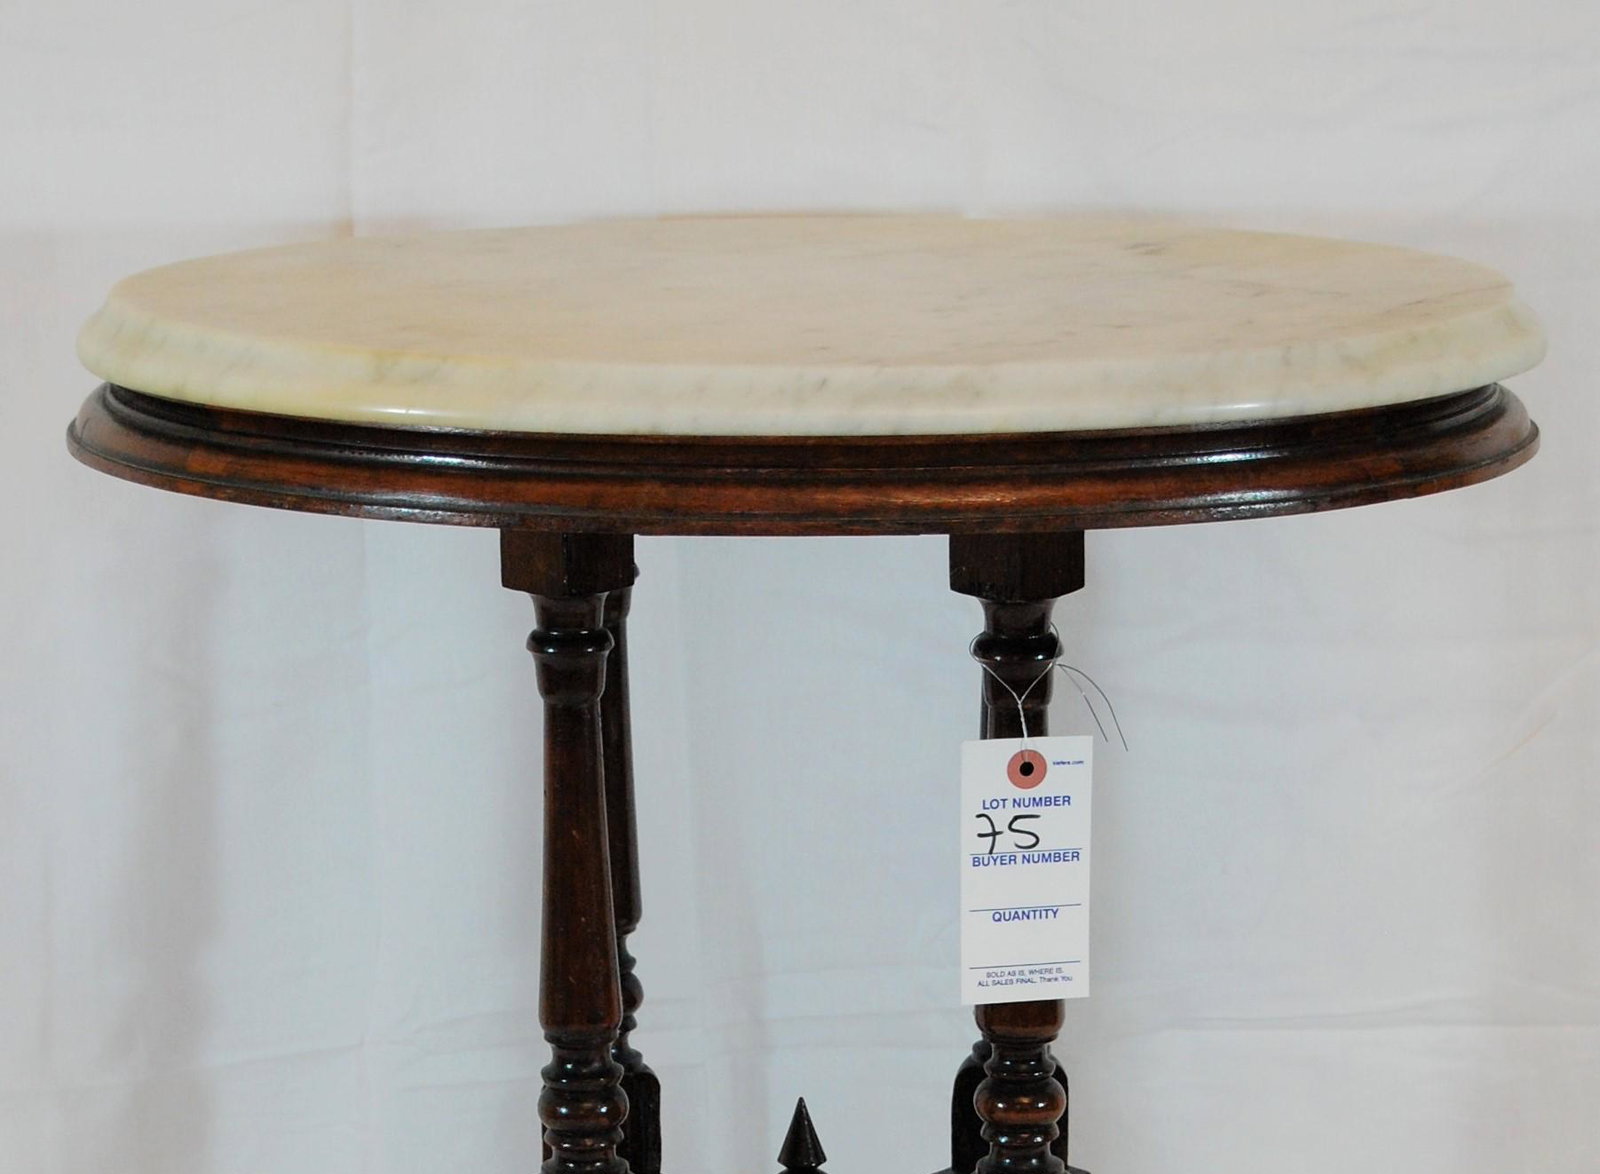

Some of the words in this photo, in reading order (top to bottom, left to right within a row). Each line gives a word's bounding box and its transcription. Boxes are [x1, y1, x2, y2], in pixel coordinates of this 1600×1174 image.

[982, 798, 1008, 810] LOT
[1012, 795, 1071, 808] NUMBER
[975, 813, 1041, 855] 75
[972, 854, 1017, 867] BUYER
[1022, 851, 1080, 864] NUMBER
[992, 908, 1059, 922] QUANTITY
[986, 971, 1006, 979] SOLD
[1028, 967, 1054, 975] WHERE
[991, 978, 1014, 986] SALES
